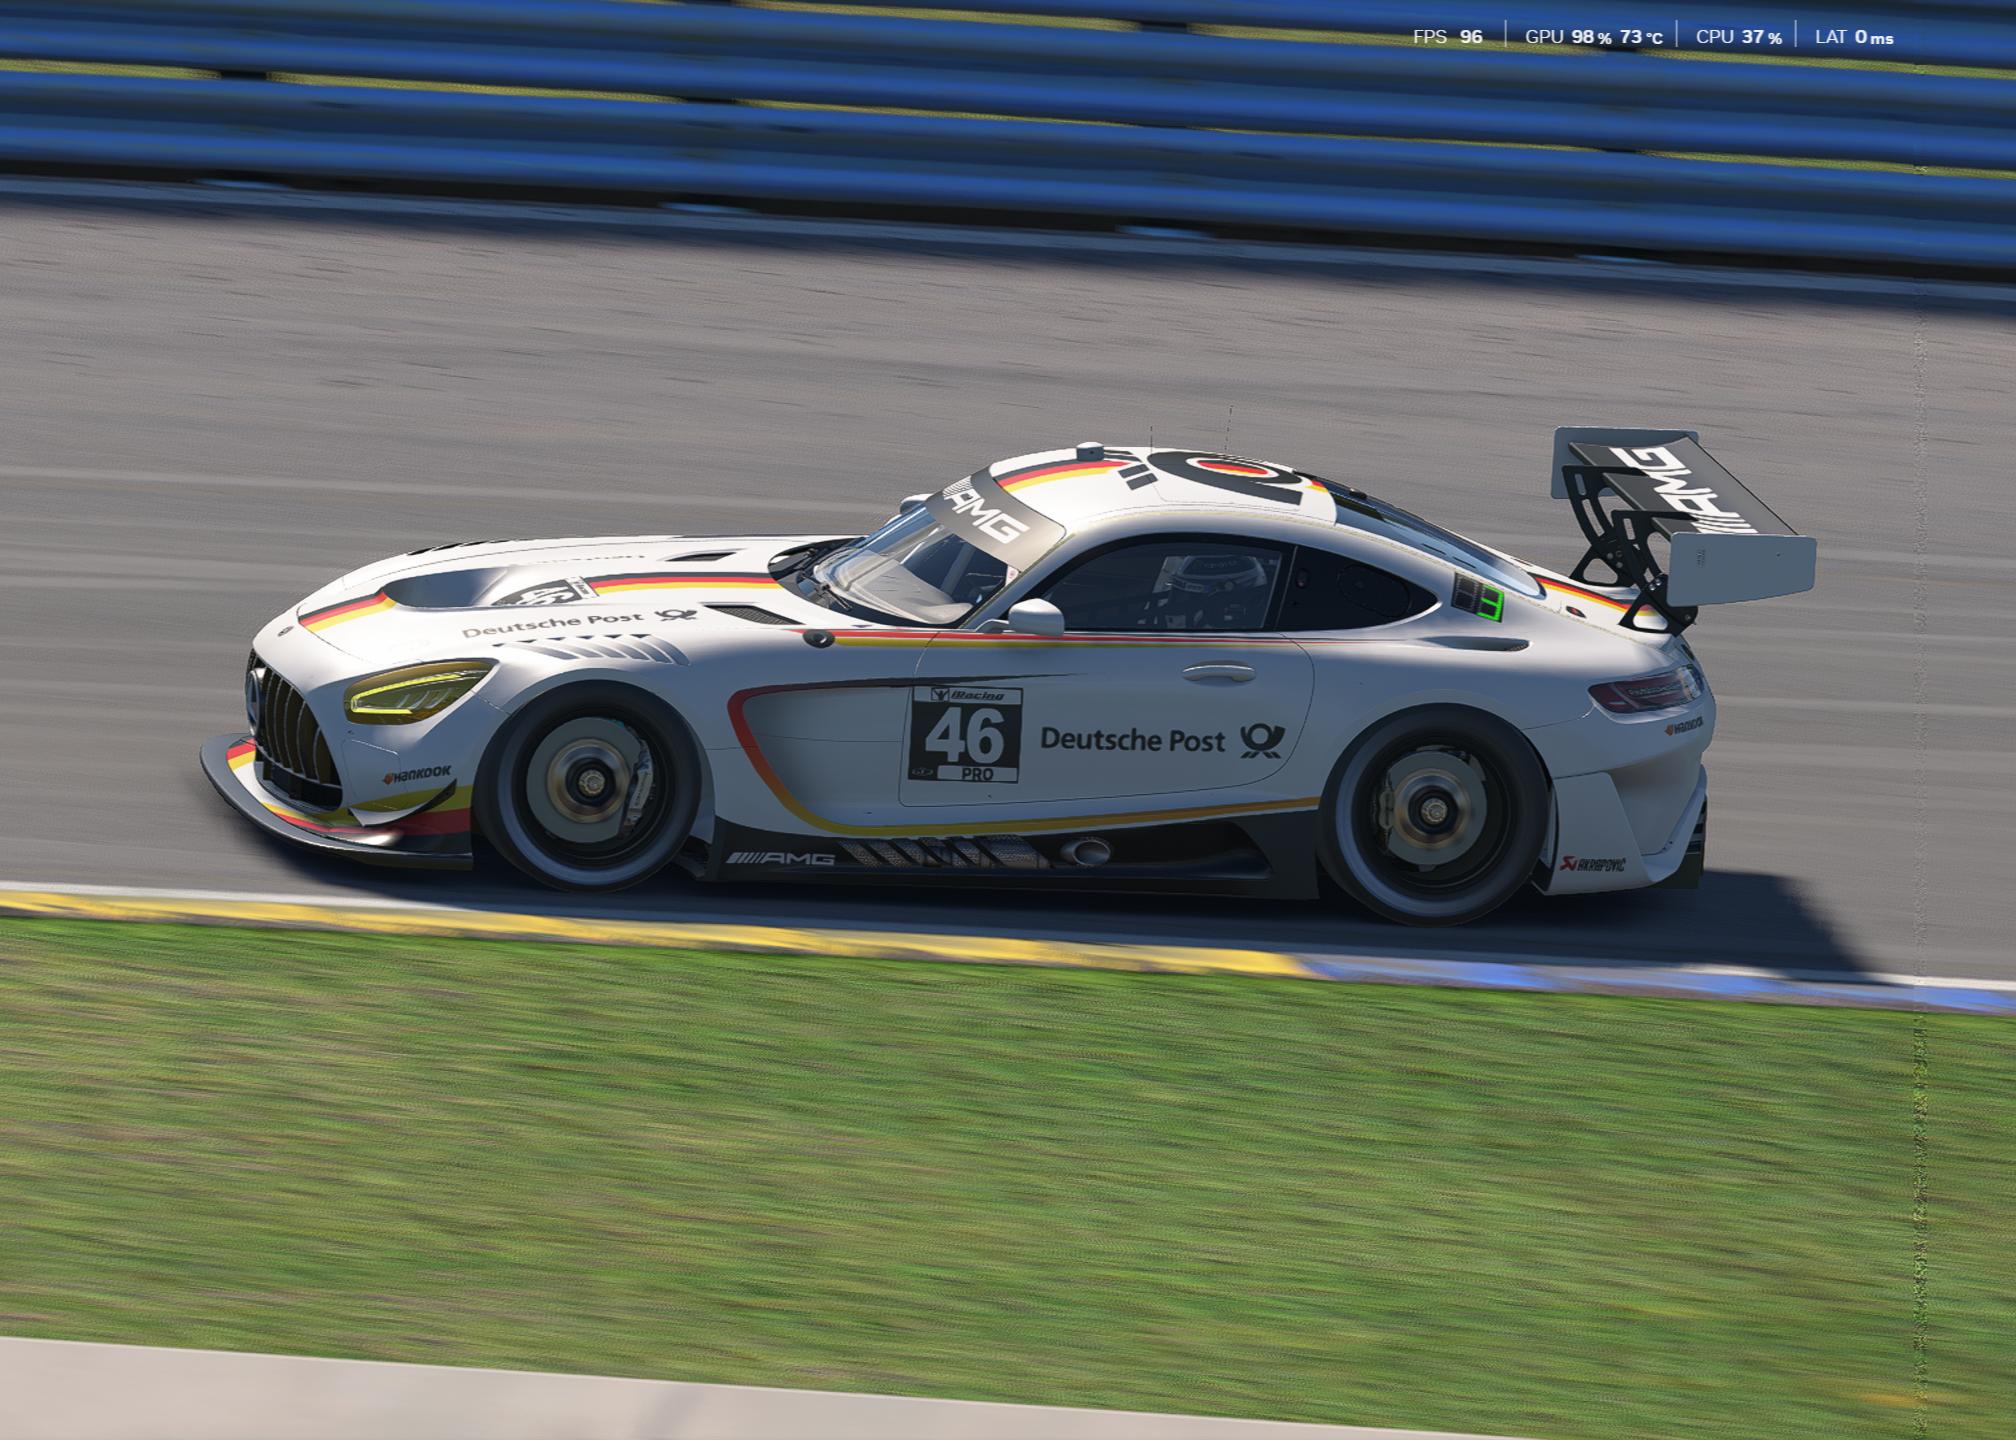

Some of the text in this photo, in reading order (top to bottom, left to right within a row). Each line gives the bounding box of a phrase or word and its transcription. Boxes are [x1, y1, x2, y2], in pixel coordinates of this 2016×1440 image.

[1609, 446, 1741, 519] AMG
[943, 488, 1031, 544] AMG
[462, 612, 646, 639] Deutsche Post
[951, 690, 1006, 701] iRacing
[925, 706, 1005, 764] 46
[1041, 726, 1226, 753] Deutsche Post
[962, 767, 994, 781] PRO
[760, 852, 836, 866] AMG
